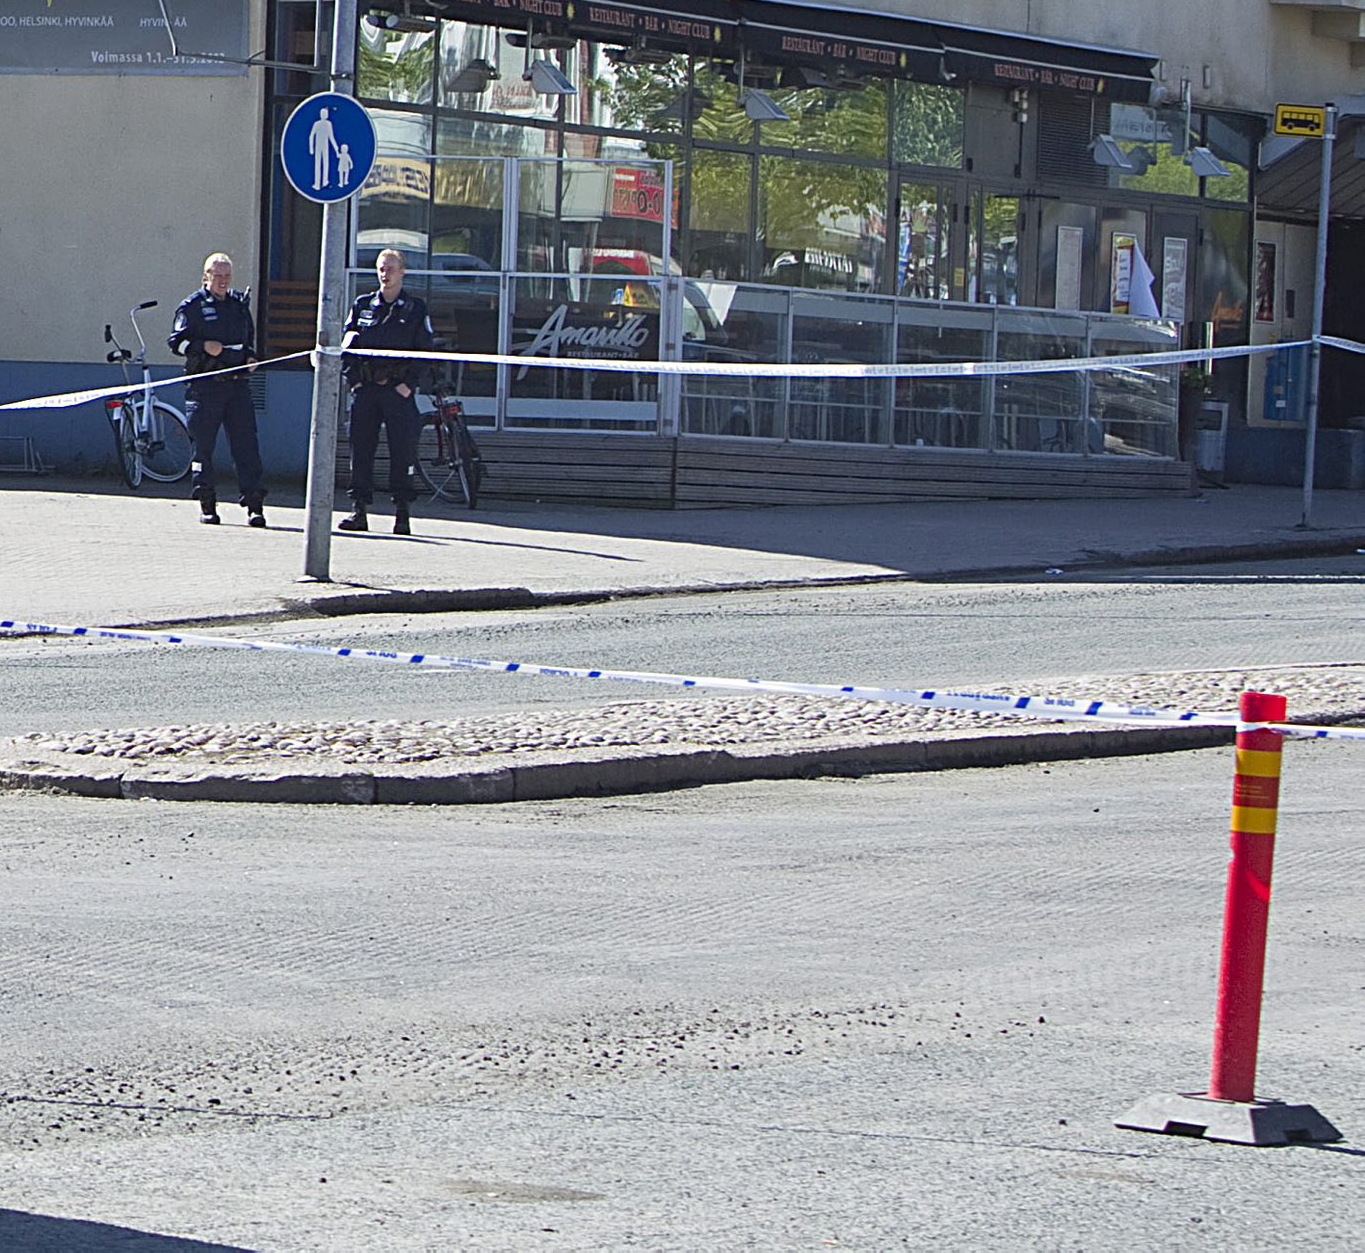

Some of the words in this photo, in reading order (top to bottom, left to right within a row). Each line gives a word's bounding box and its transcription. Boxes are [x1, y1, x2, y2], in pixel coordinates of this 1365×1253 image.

[543, 0, 563, 17] CLUB
[19, 17, 63, 27] HELSINKI,
[65, 15, 114, 27] HYVINKÄÄ
[140, 16, 188, 27] HYVINÄÄ
[644, 16, 658, 32] BAR
[668, 19, 692, 36] NIGHT
[692, 22, 710, 39] CLUB
[91, 51, 142, 63] Voimassa
[516, 303, 650, 381] Amarillo
